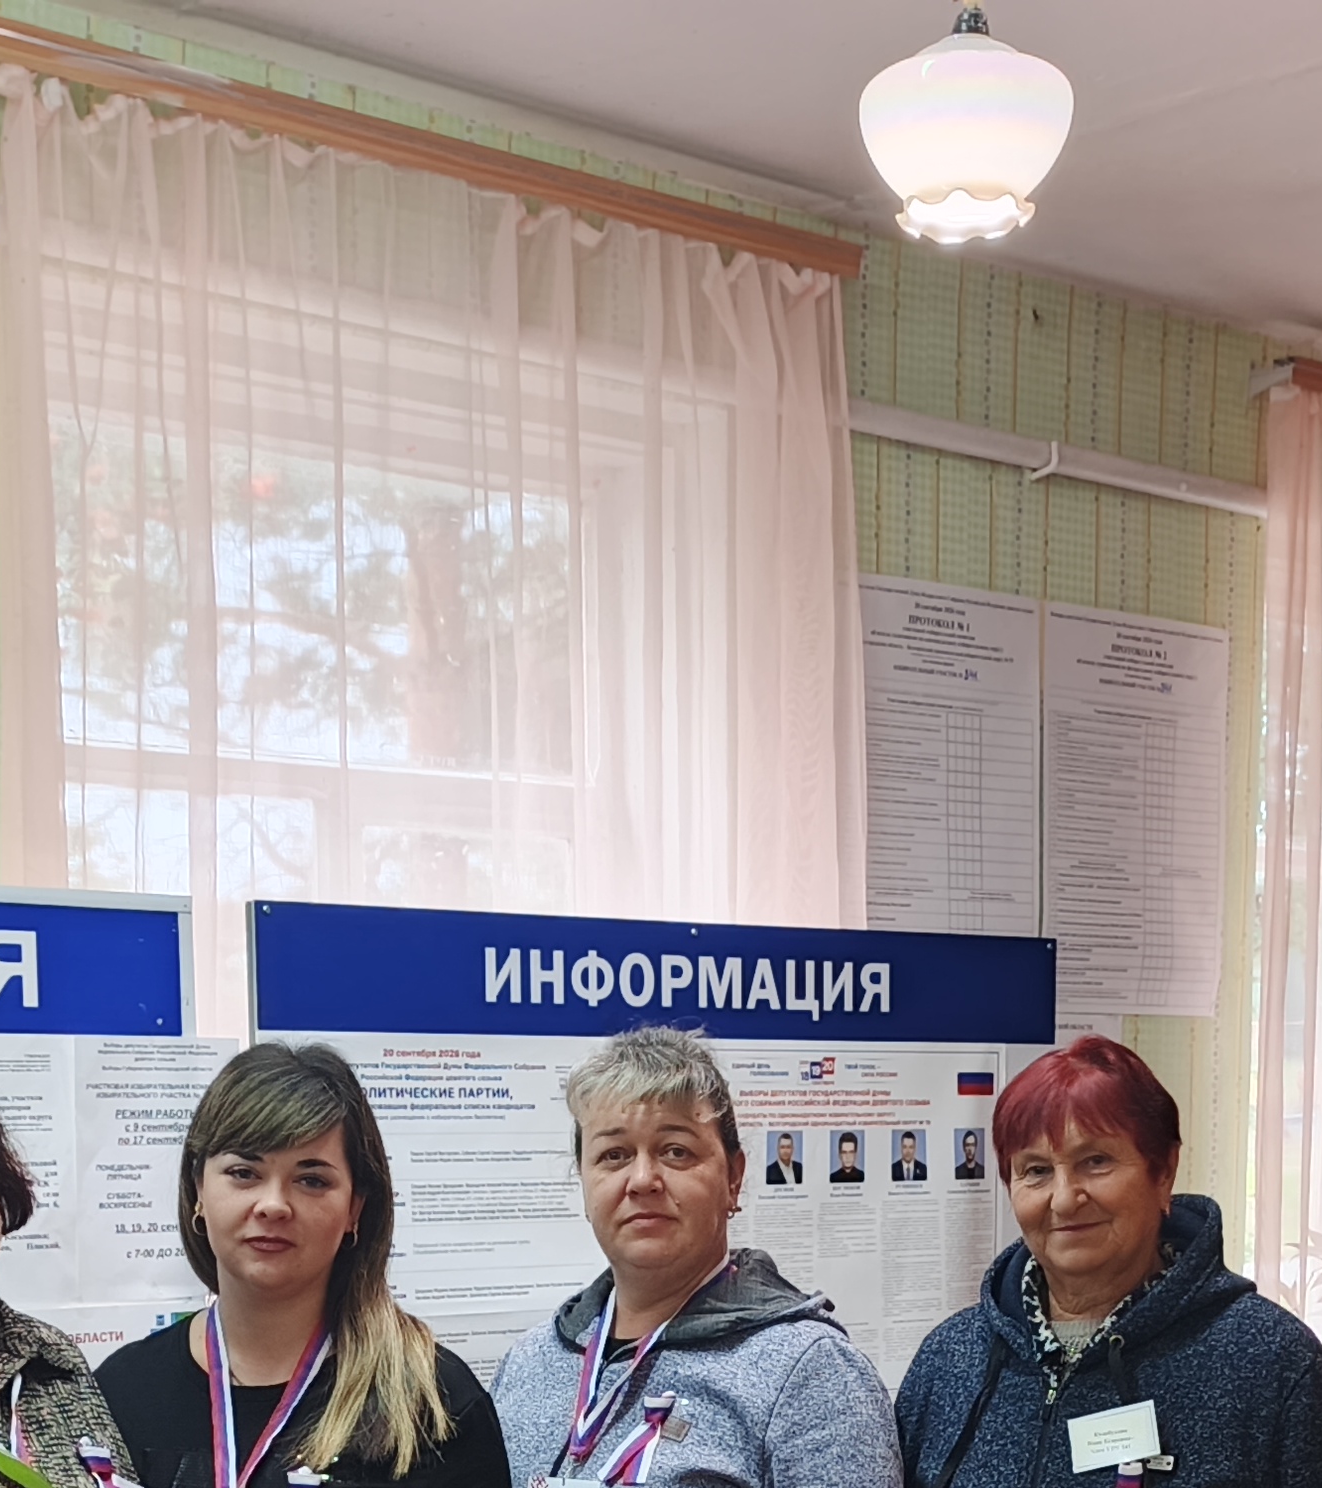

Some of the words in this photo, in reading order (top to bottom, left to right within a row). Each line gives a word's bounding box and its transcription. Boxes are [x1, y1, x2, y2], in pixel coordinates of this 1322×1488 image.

[483, 946, 892, 1021] ИНФОРМАЦИЯ
[383, 1049, 394, 1057] 20
[396, 1049, 436, 1058] сентября
[461, 1051, 481, 1059] года
[811, 1064, 822, 1075] 19
[822, 1060, 834, 1071] 20
[362, 1087, 455, 1099] ОЛИТИЧЕСКИЕ
[459, 1088, 513, 1100] ПАРТИИ,
[115, 1109, 153, 1119] РЕЖИМ
[134, 1248, 154, 1258] 7-00
[156, 1248, 172, 1260] ДО
